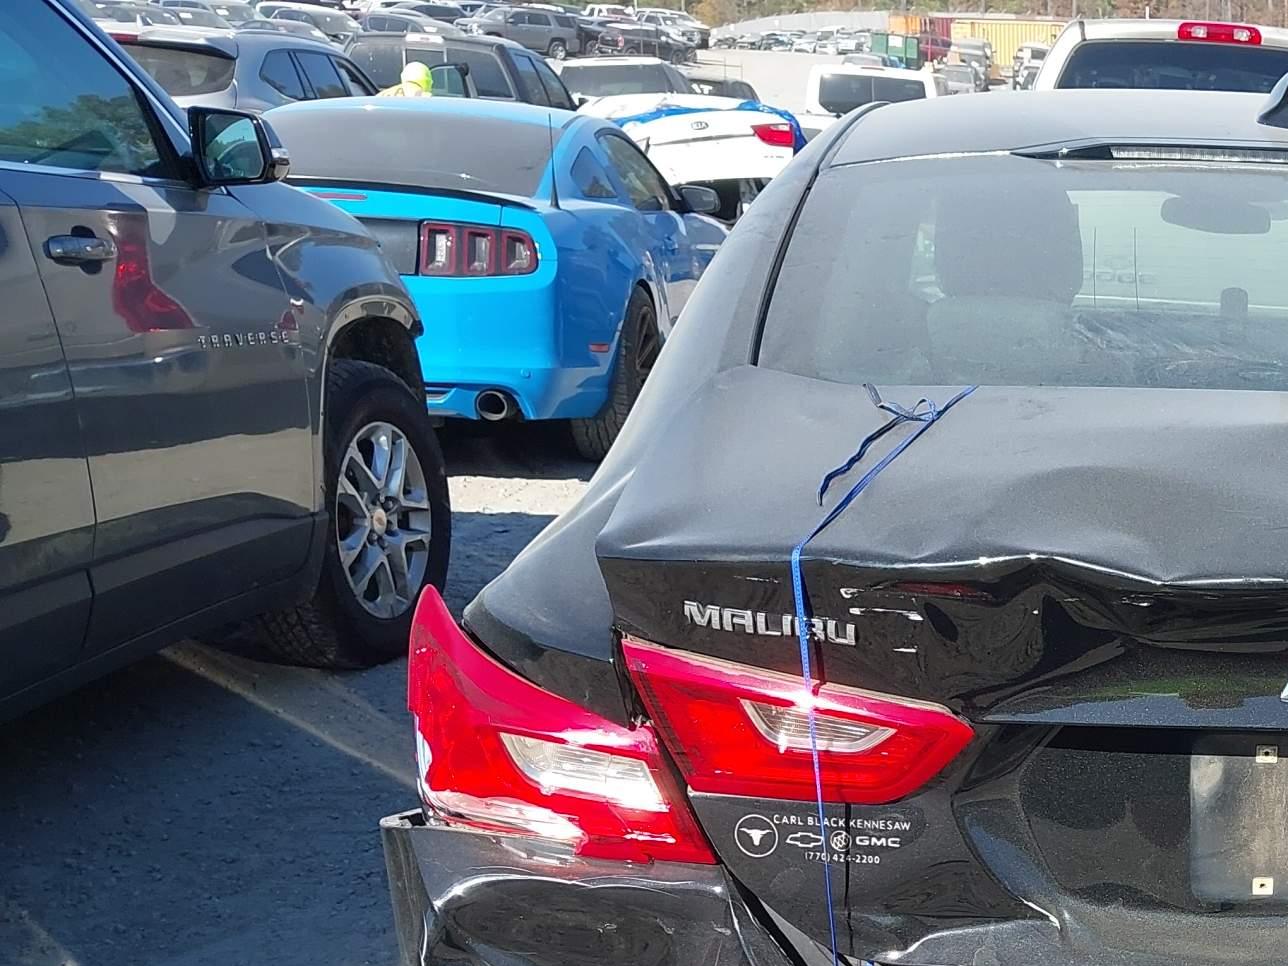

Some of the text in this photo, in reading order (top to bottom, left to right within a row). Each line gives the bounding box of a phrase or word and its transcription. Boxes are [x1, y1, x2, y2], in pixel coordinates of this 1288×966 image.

[691, 121, 709, 130] KIA
[197, 331, 290, 349] TRAVERSE
[773, 814, 911, 831] CARL BLACK KENNESAW
[855, 835, 901, 848] GMC
[804, 851, 831, 863] (770)
